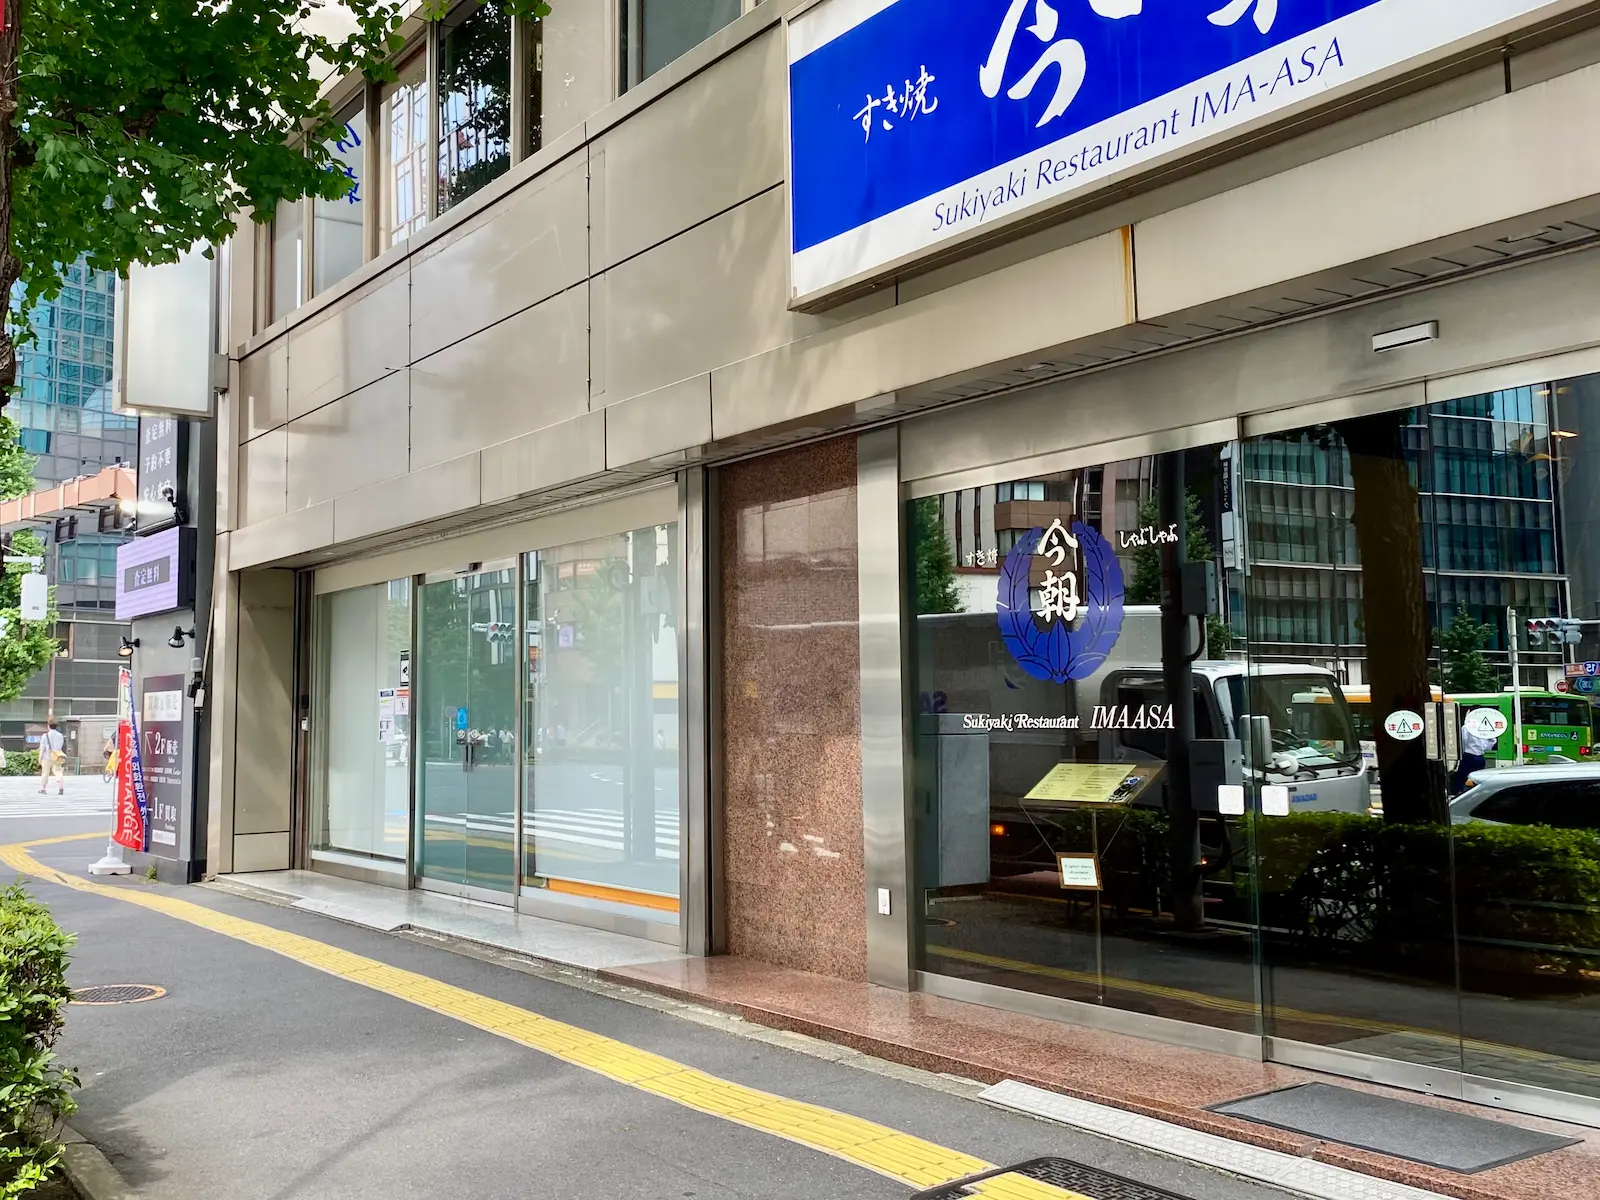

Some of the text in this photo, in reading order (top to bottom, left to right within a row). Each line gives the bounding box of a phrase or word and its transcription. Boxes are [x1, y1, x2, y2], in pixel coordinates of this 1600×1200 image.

[853, 65, 938, 144] すき焼
[932, 36, 1345, 233] Sukiyaki Restaurant IMA-ASA
[1119, 523, 1179, 548] しゃぶしゃぶ
[134, 563, 160, 587] 査定無料
[1036, 517, 1080, 622] 今朝
[963, 713, 1013, 731] Sukiyaki
[1014, 714, 1079, 729] Restaurant
[155, 732, 166, 755] 2F
[153, 797, 164, 820] 1F
